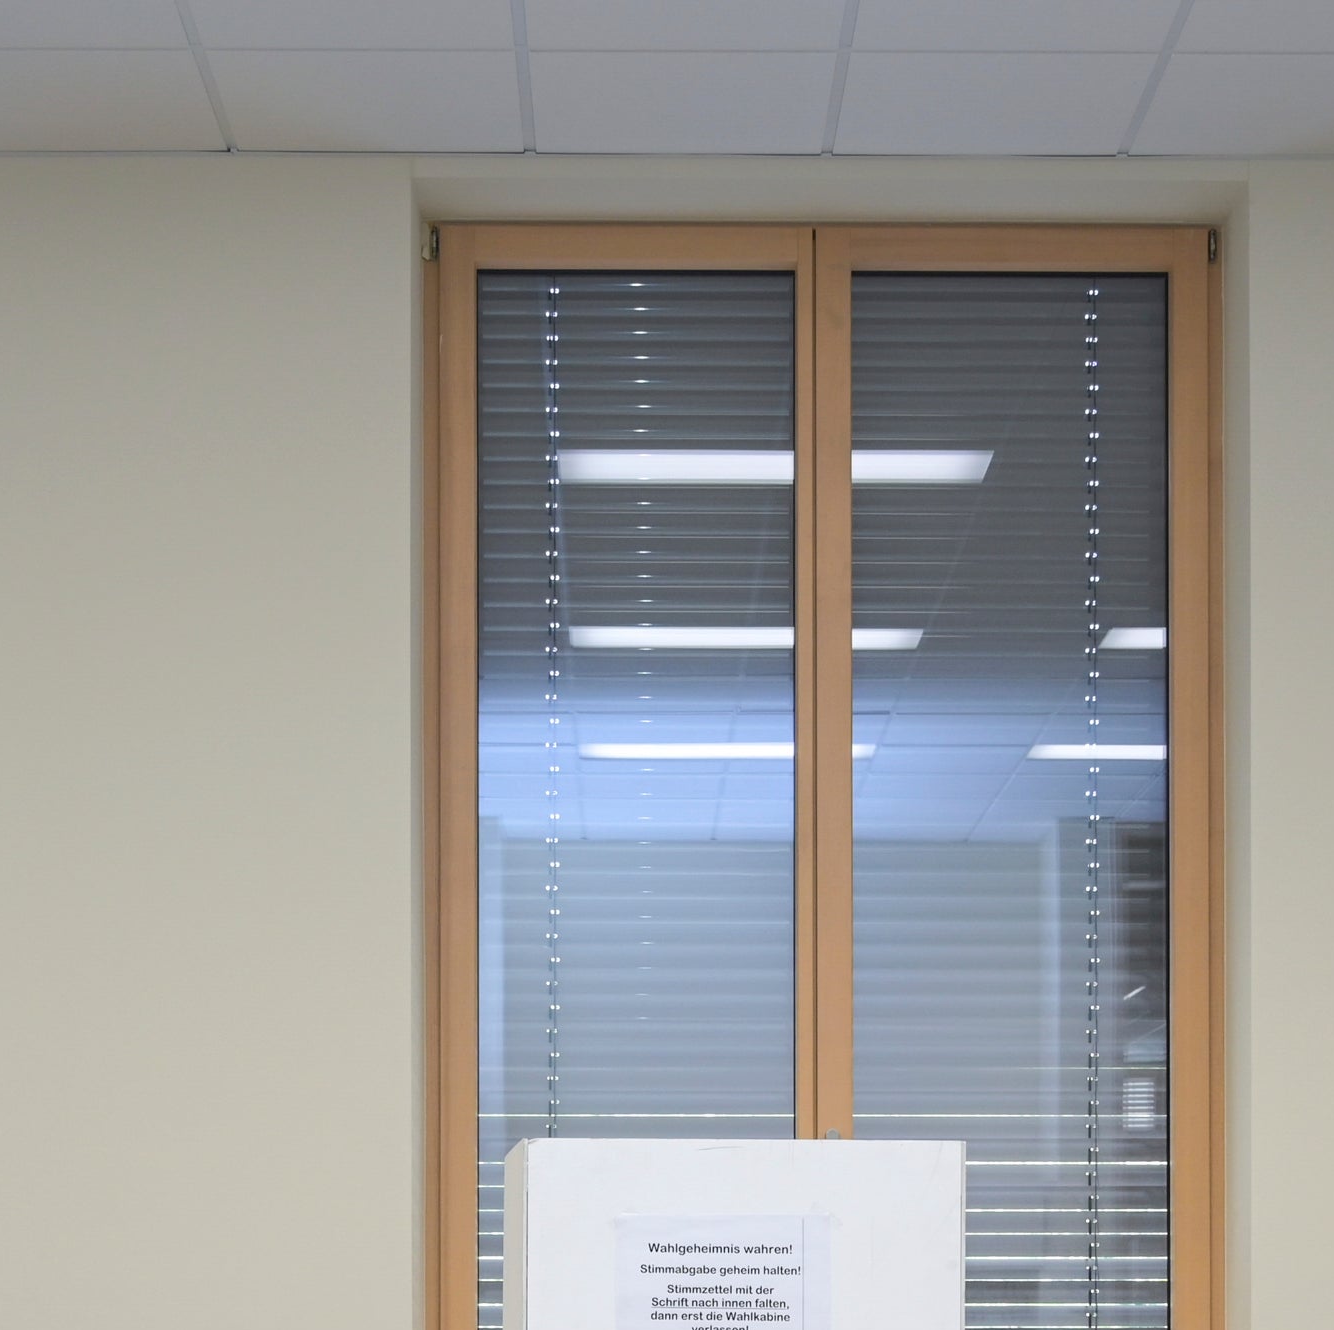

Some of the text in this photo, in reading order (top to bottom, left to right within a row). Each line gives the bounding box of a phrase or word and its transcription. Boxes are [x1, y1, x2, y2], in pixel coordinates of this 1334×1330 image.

[648, 1243, 793, 1255] Wahlgeheimnis wahren!
[640, 1265, 801, 1276] Stimmabgabe geheim halten!
[667, 1285, 774, 1295] Stimmzettel mit der
[651, 1298, 790, 1309] Schrift nach innen falten,
[651, 1311, 790, 1322] dann erst die Wahlkabine
